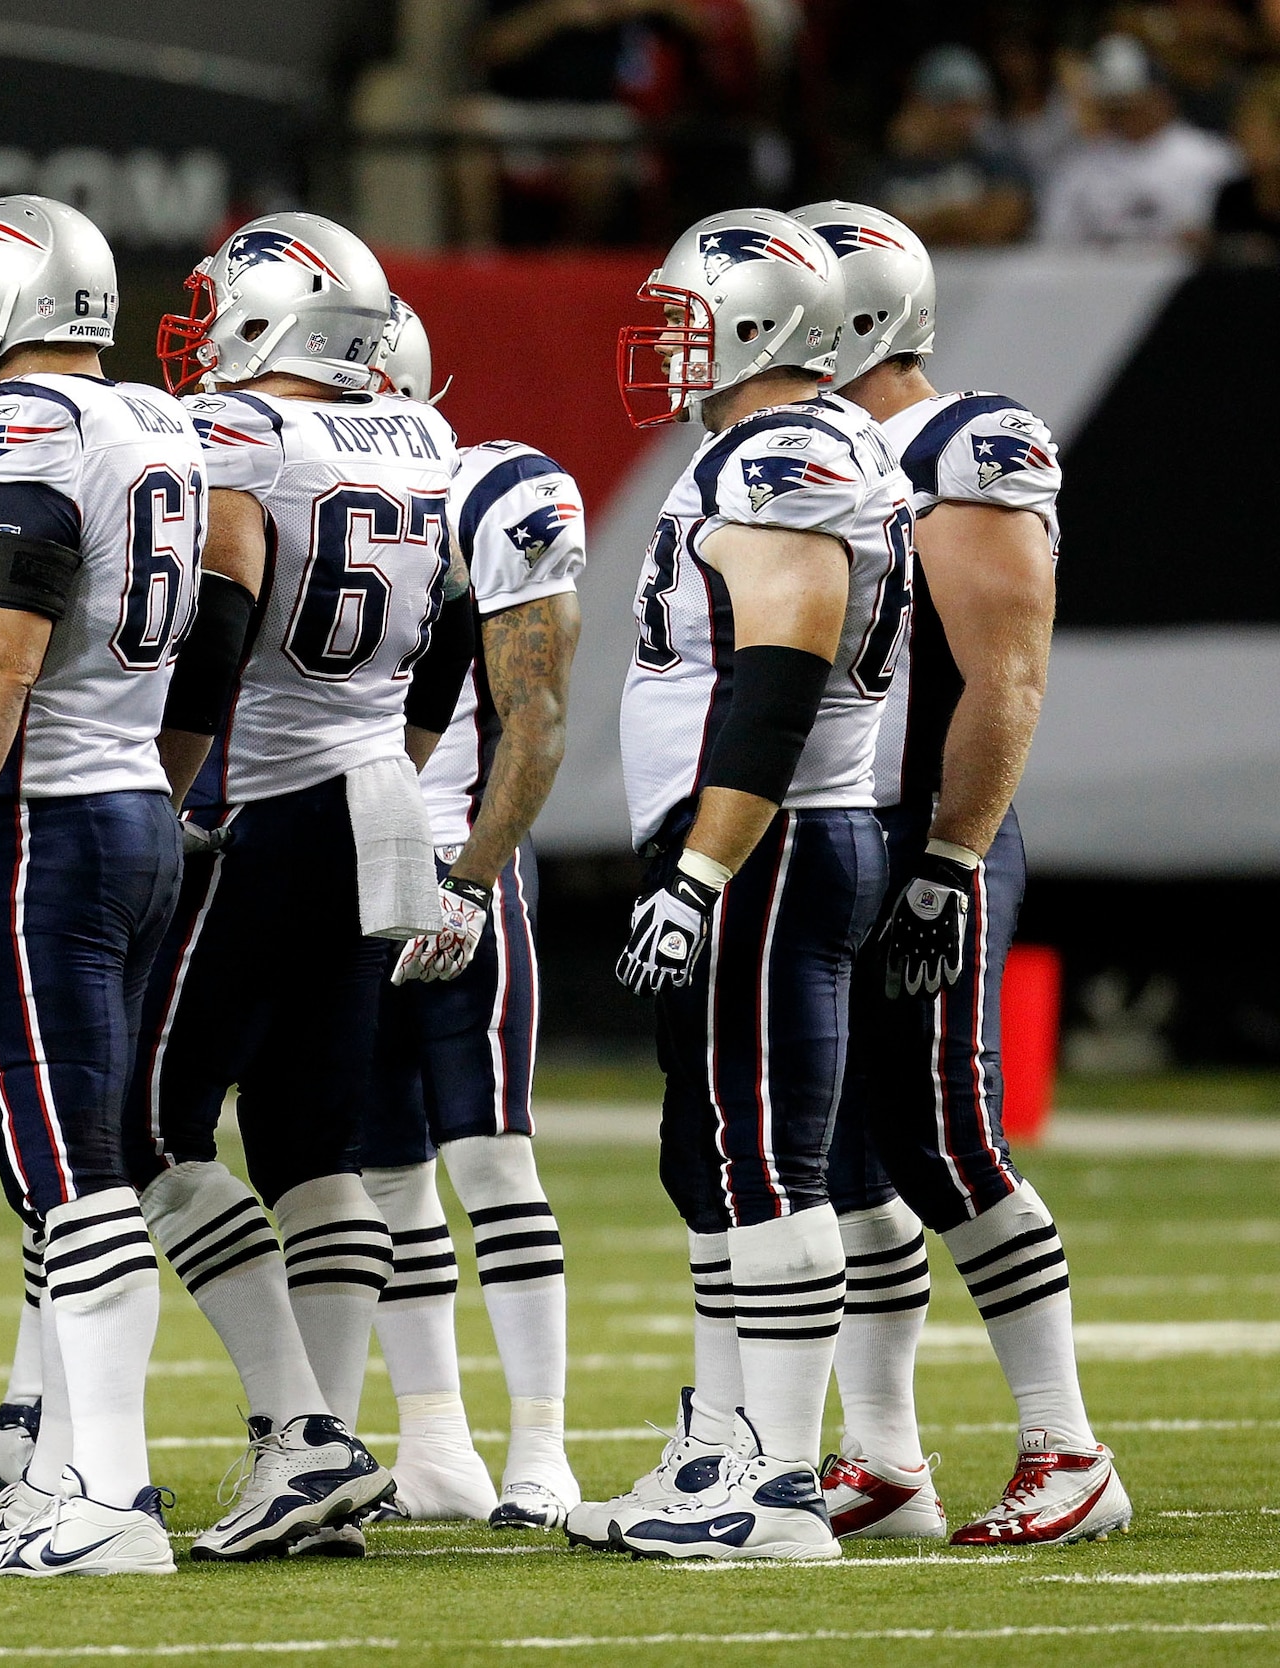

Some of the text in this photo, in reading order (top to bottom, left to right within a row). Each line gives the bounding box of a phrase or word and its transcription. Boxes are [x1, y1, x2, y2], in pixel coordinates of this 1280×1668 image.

[69, 325, 111, 338] PATRIOTS
[314, 411, 441, 460] KOPPEN
[282, 481, 451, 682] 67
